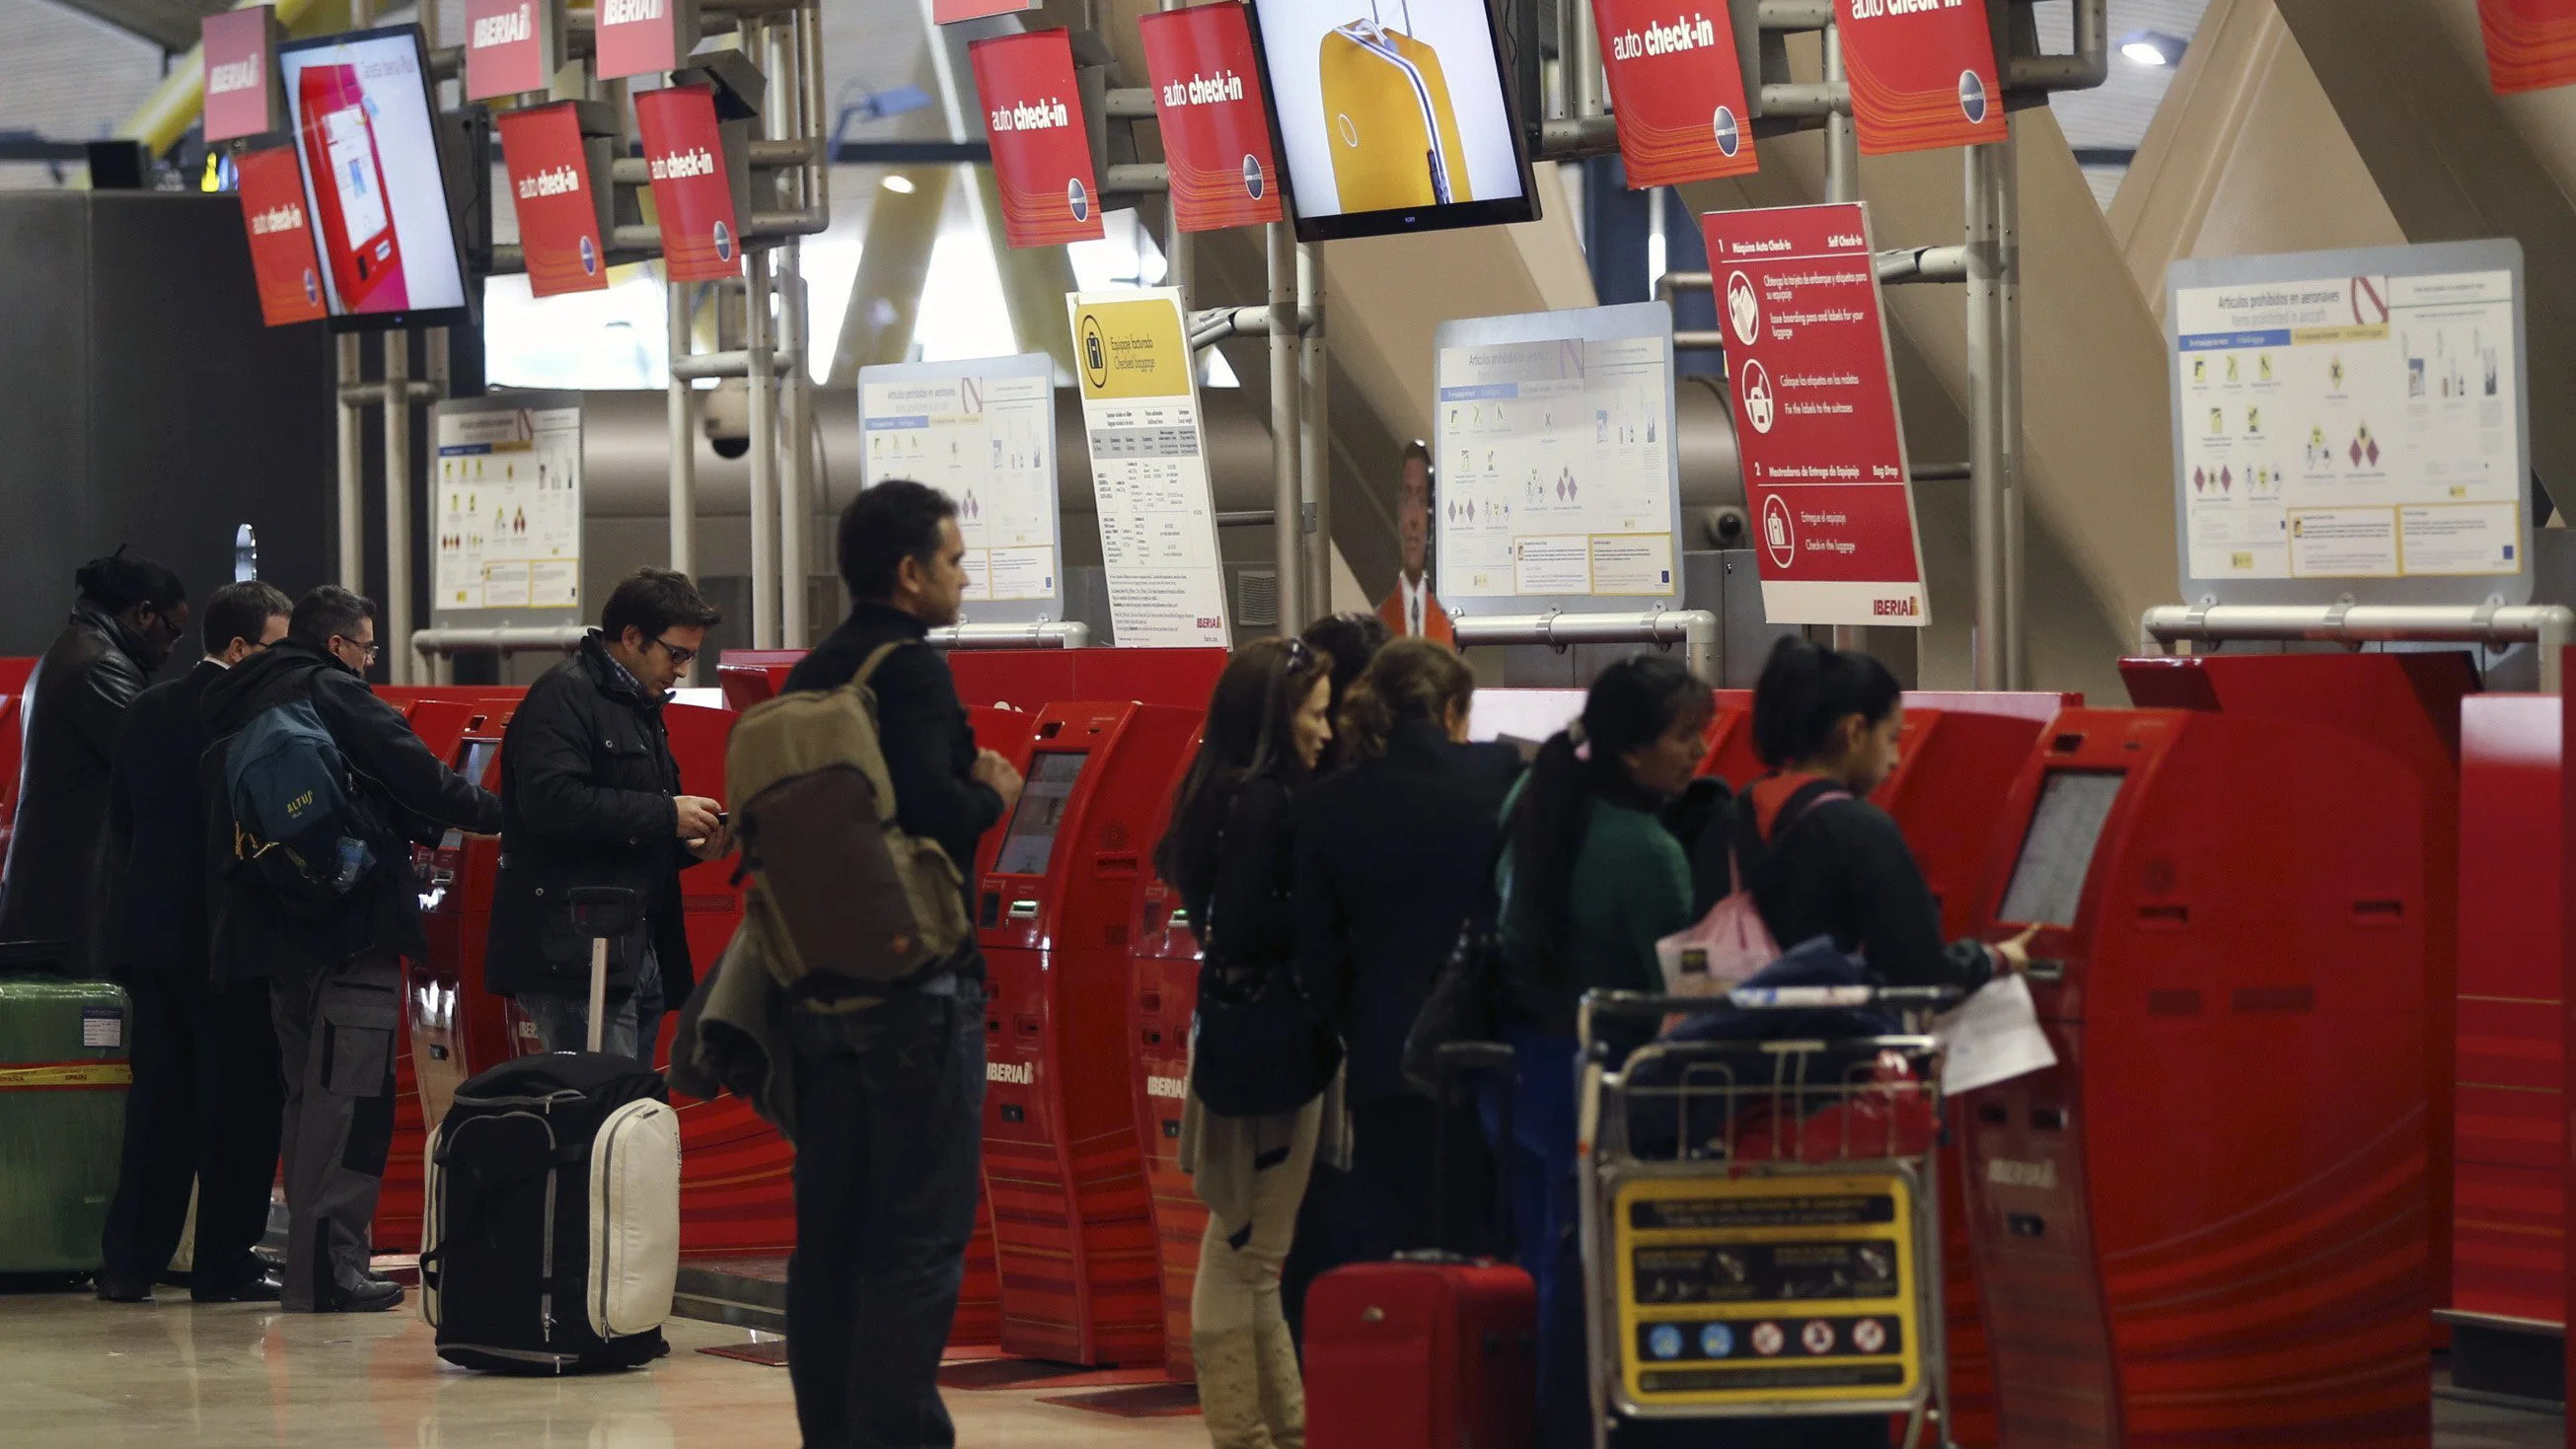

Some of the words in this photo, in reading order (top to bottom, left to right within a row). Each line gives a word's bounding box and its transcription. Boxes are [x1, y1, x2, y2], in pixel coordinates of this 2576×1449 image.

[474, 12, 521, 48] IBERIA
[1613, 29, 1643, 61] auto
[1645, 13, 1715, 56] check-in
[1163, 79, 1187, 108] auto
[1188, 69, 1243, 106] check-in
[992, 106, 1013, 131] auto
[1014, 97, 1068, 130] check-in
[651, 156, 667, 180] auto
[667, 146, 714, 179] check-in
[519, 177, 538, 199] auto
[538, 165, 579, 196] check-in
[267, 202, 304, 233] check-in
[1719, 239, 1725, 253] 1
[1732, 242, 1756, 255] Máquina
[1756, 241, 1768, 253] Auto
[1827, 236, 1839, 248] Self
[1803, 272, 1809, 285] de
[1783, 311, 1806, 326] boarding
[1806, 314, 1818, 326] pass
[1817, 309, 1828, 322] and
[1828, 308, 1844, 322] labels
[1843, 308, 1852, 321] for
[1852, 312, 1864, 324] your
[1772, 325, 1794, 340] luggage
[1780, 374, 1800, 390] Coloque
[1806, 374, 1827, 389] etiquetas
[1827, 377, 1833, 386] en
[1793, 401, 1802, 414] the
[1801, 401, 1816, 414] labels
[1816, 402, 1822, 413] to
[1822, 400, 1832, 413] the
[1832, 401, 1854, 413] suitcases
[1754, 462, 1761, 476] 2
[1769, 467, 1802, 477] Mostradores
[1802, 466, 1808, 477] de
[1808, 466, 1829, 479] Entrega
[1829, 465, 1837, 476] de
[1837, 465, 1860, 479] Equipaje
[1873, 465, 1884, 479] Bag
[1884, 465, 1898, 479] Drop
[1825, 539, 1834, 550] the
[1834, 539, 1856, 554] luggage
[1873, 599, 1911, 616] IBERIA
[1196, 616, 1217, 628] IBERIA
[287, 789, 314, 814] ALTUS
[987, 1061, 1024, 1084] IBERIA
[1147, 1076, 1183, 1099] IBERIA
